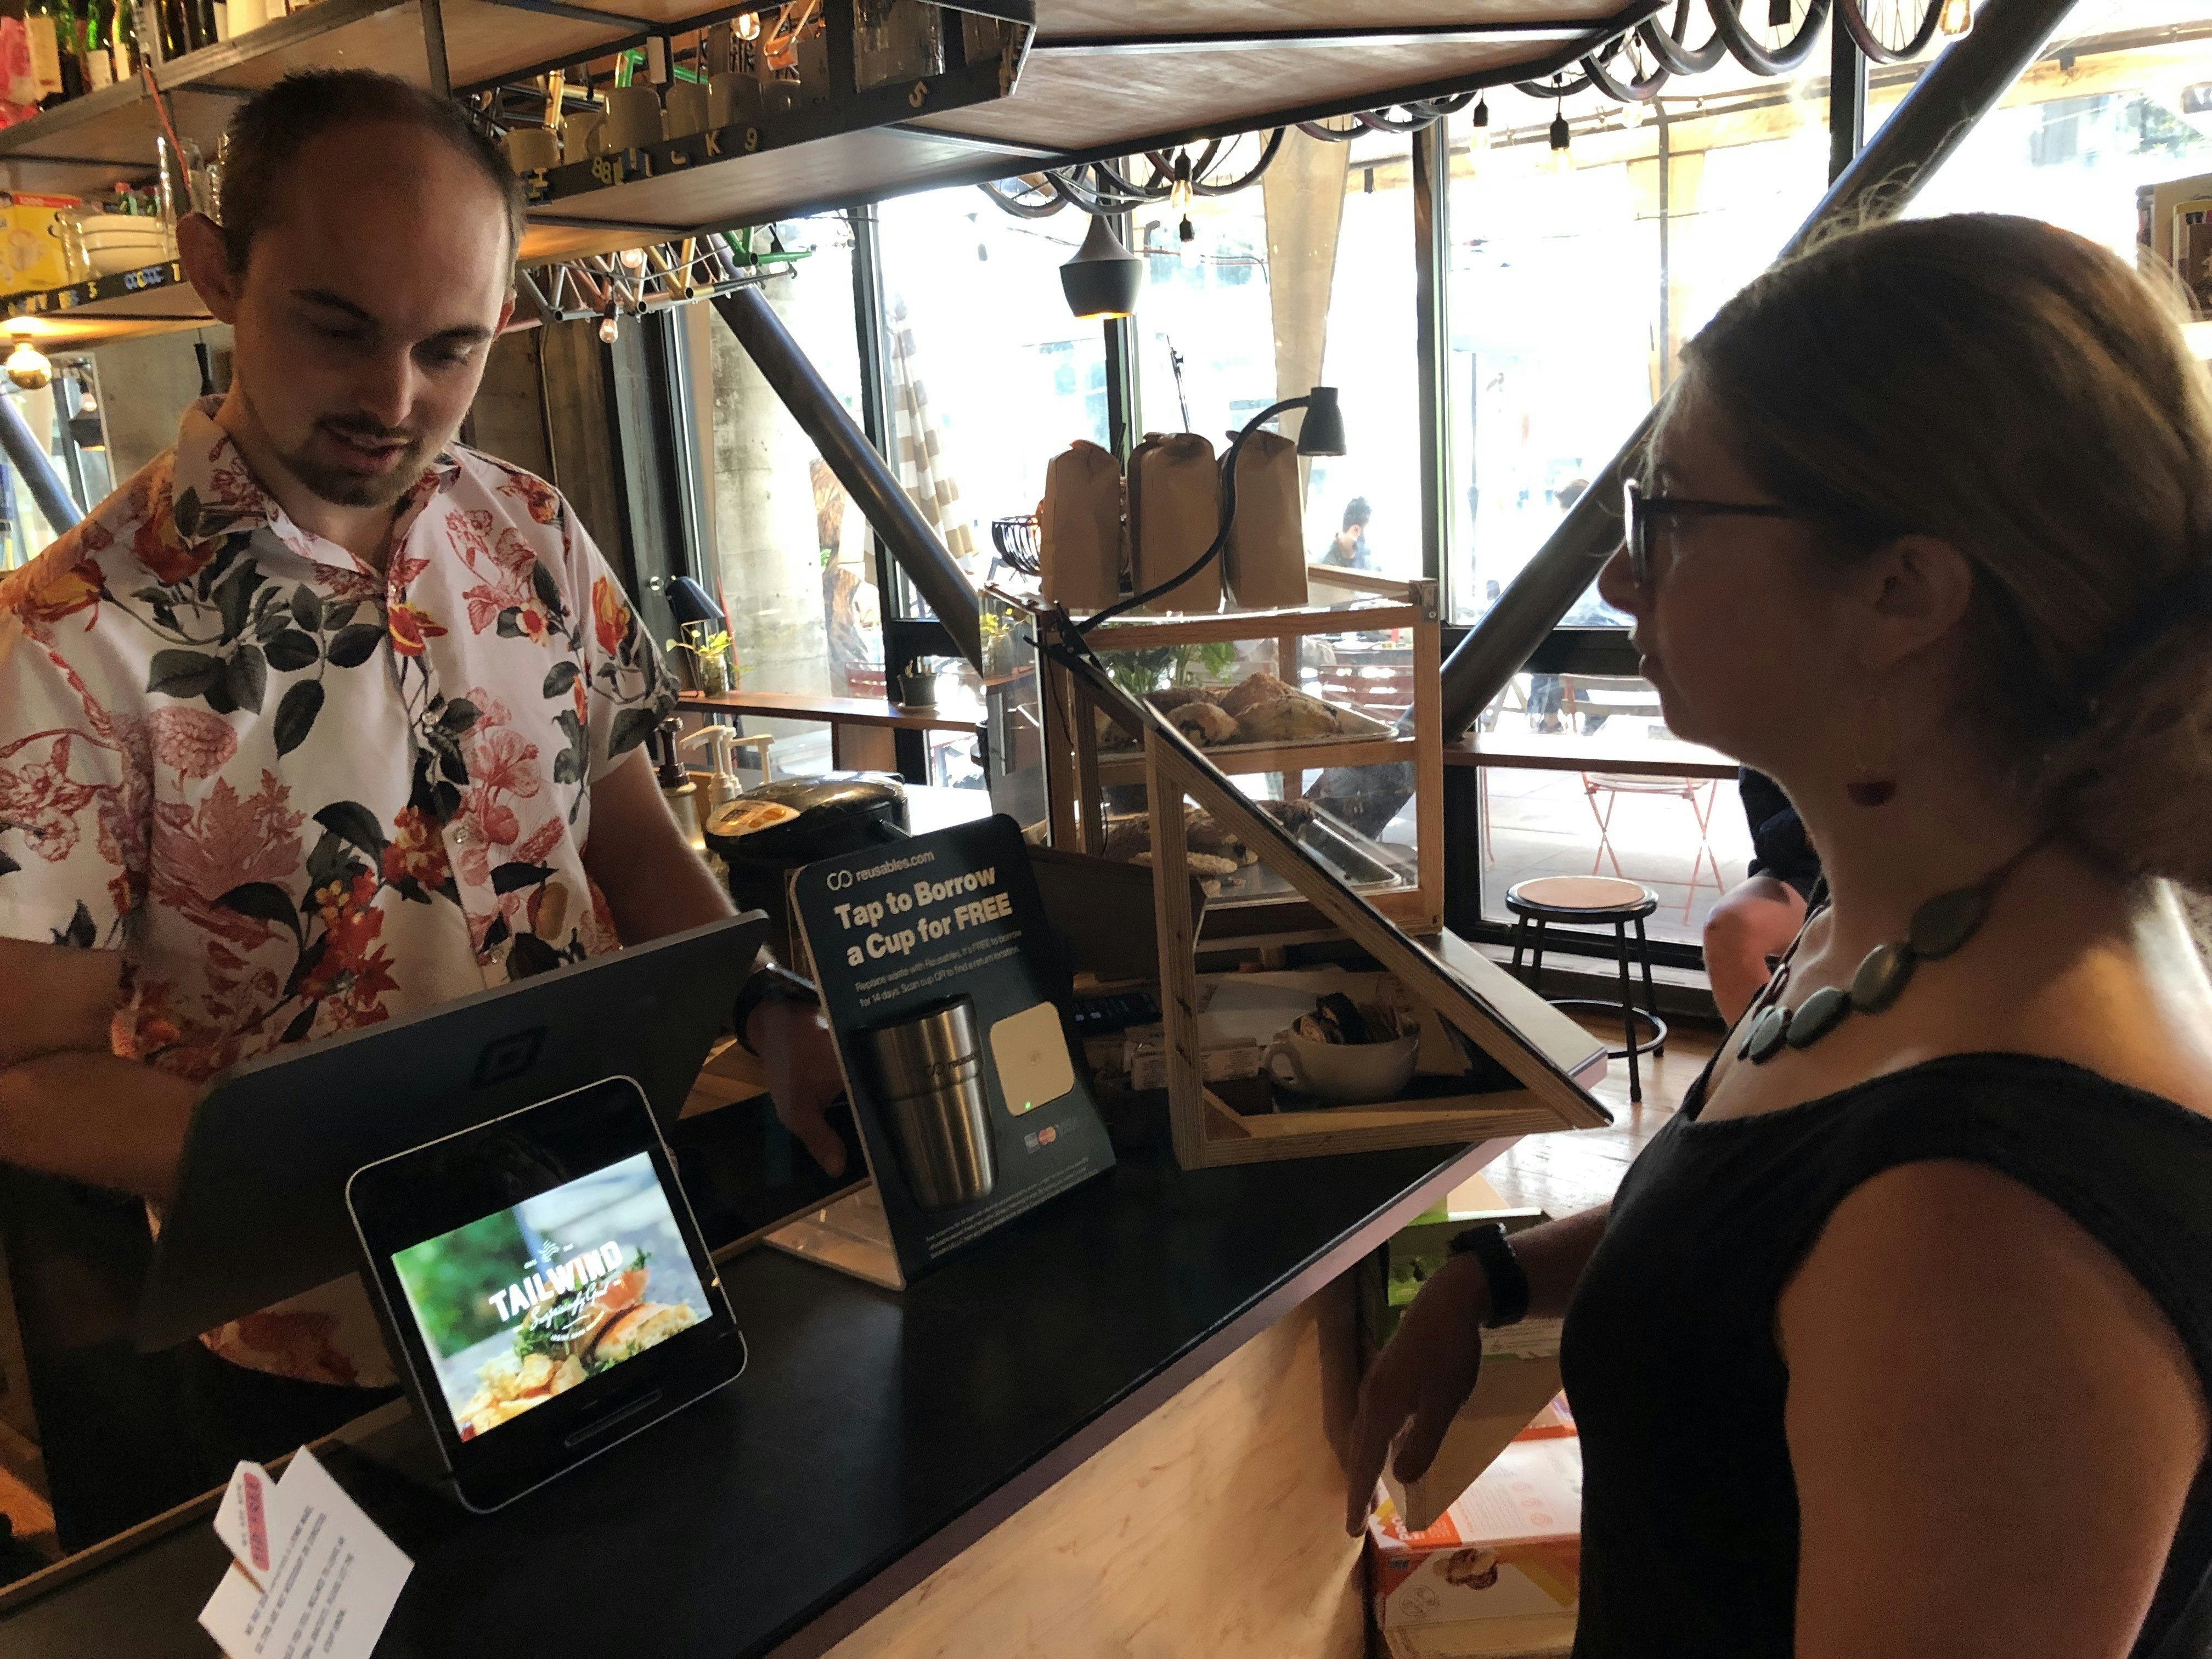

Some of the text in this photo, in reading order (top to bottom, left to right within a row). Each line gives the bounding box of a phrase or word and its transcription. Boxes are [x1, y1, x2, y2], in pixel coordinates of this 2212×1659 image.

[855, 851, 935, 882] reusables.com
[833, 866, 996, 930] Tap to Borrow
[847, 891, 1013, 967] a Cup for FREE
[910, 963, 926, 974] with
[972, 938, 991, 951] FREE
[998, 930, 1022, 944] borrow
[901, 980, 920, 994] Scan
[488, 1240, 623, 1323] TAILWIND
